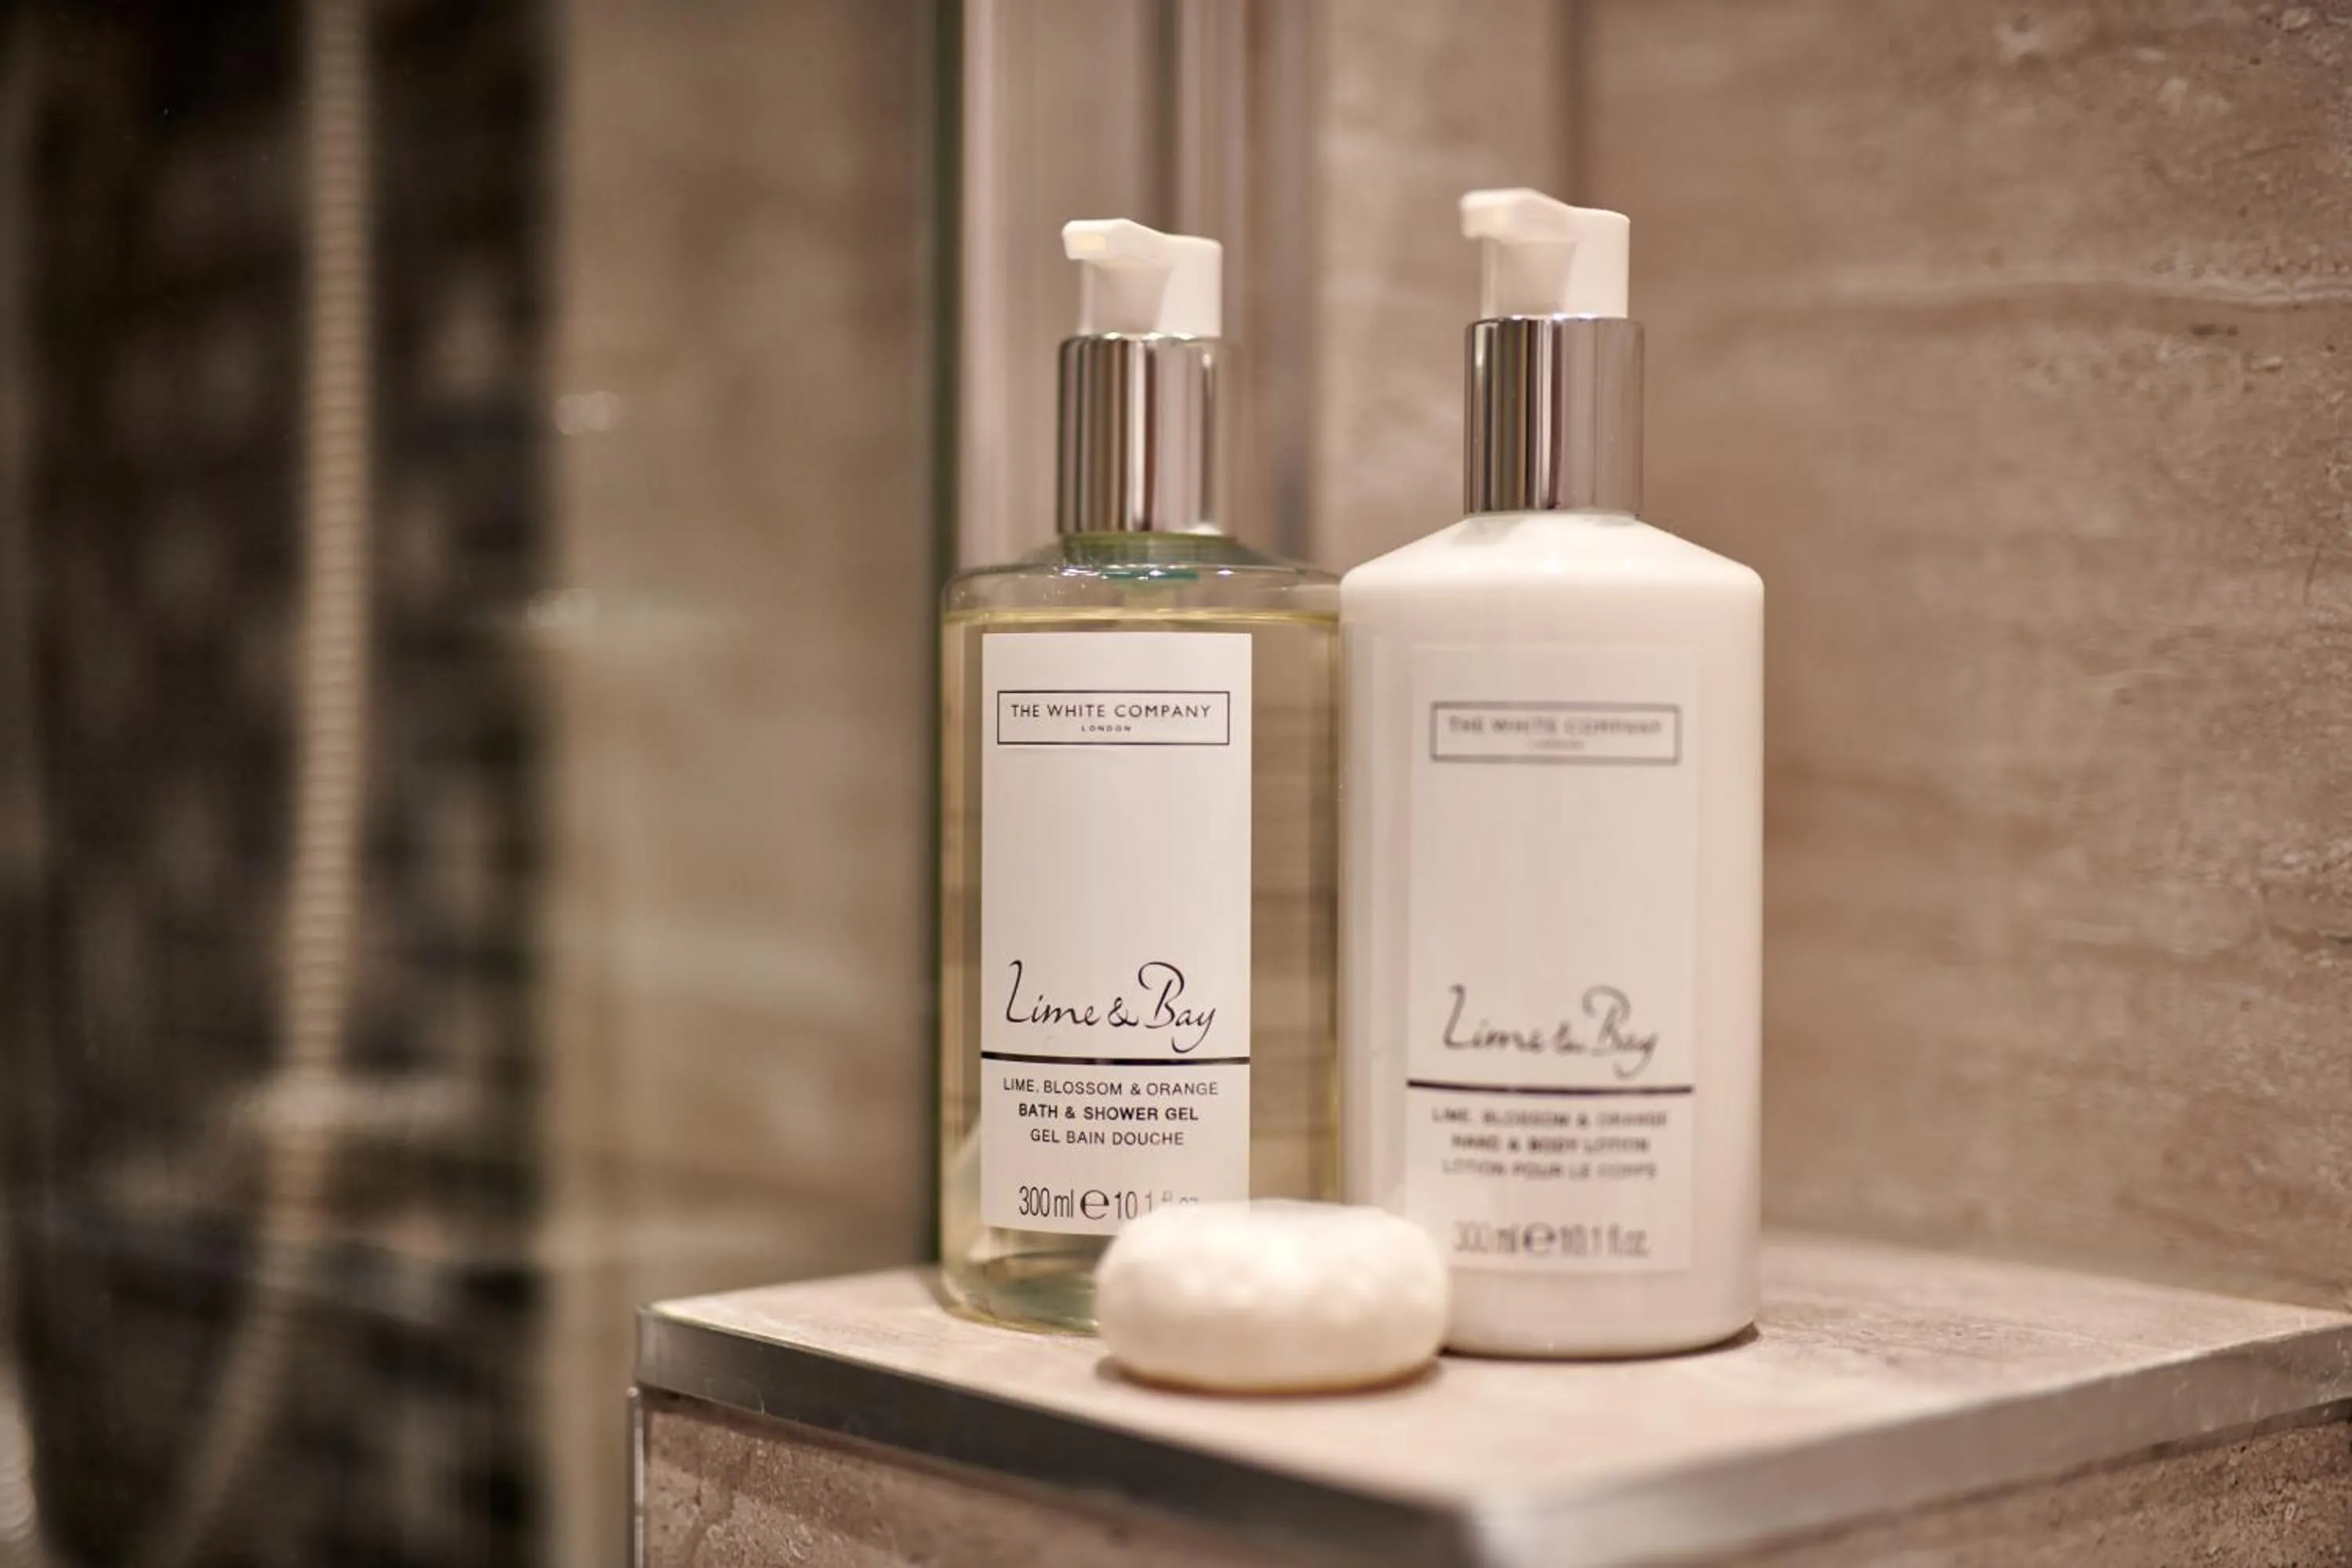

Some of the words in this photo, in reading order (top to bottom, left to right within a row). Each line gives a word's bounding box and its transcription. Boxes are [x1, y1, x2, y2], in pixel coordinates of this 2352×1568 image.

[1011, 705, 1040, 718] THE
[1047, 705, 1105, 718] WHITE
[1114, 705, 1212, 719] COMPANY
[1006, 960, 1100, 1027] Lime
[1107, 996, 1140, 1027] &
[1138, 961, 1216, 1054] Bay
[1443, 984, 1543, 1055] Lime
[1581, 985, 1660, 1080] Bay
[1044, 1080, 1122, 1096] BLOSSOM
[1130, 1082, 1142, 1096] &
[1146, 1082, 1218, 1096] ORANGE
[1018, 1103, 1058, 1119] BATH
[1065, 1106, 1076, 1119] &
[1083, 1106, 1159, 1121] SHOWER
[1165, 1107, 1199, 1121] GEL
[1030, 1128, 1060, 1143] GEL
[1066, 1130, 1105, 1145] BAIN
[1112, 1131, 1185, 1146] DOUCHE
[1114, 1190, 1152, 1220] 101
